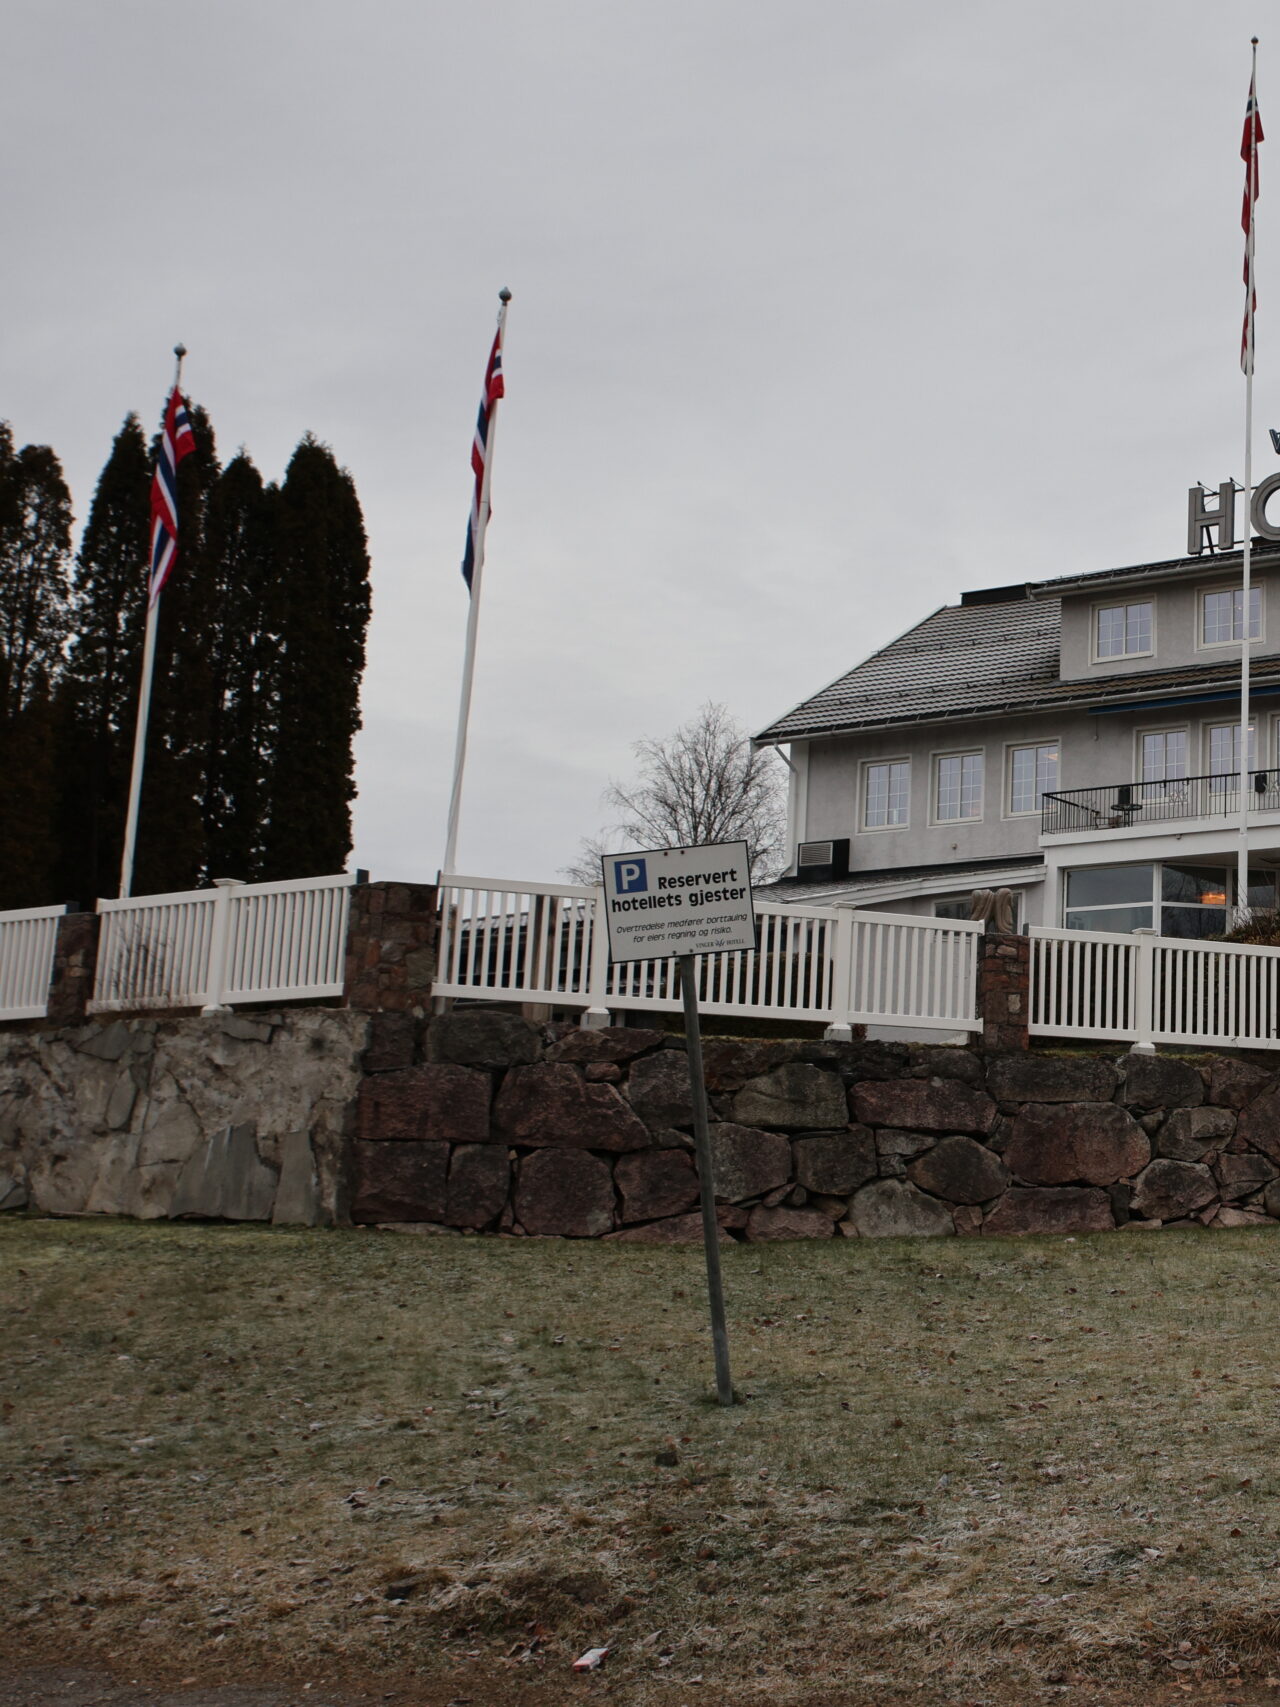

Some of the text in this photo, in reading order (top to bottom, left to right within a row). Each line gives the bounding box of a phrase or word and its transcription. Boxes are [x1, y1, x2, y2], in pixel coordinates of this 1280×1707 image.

[620, 863, 640, 890] P
[658, 868, 737, 890] Reservert
[612, 887, 746, 913] hotellets gjester
[616, 922, 665, 934] Overtredelse
[667, 918, 704, 929] medfører
[633, 934, 645, 943] for
[647, 933, 665, 942] eiers
[667, 930, 697, 940] regning
[698, 928, 708, 937] og
